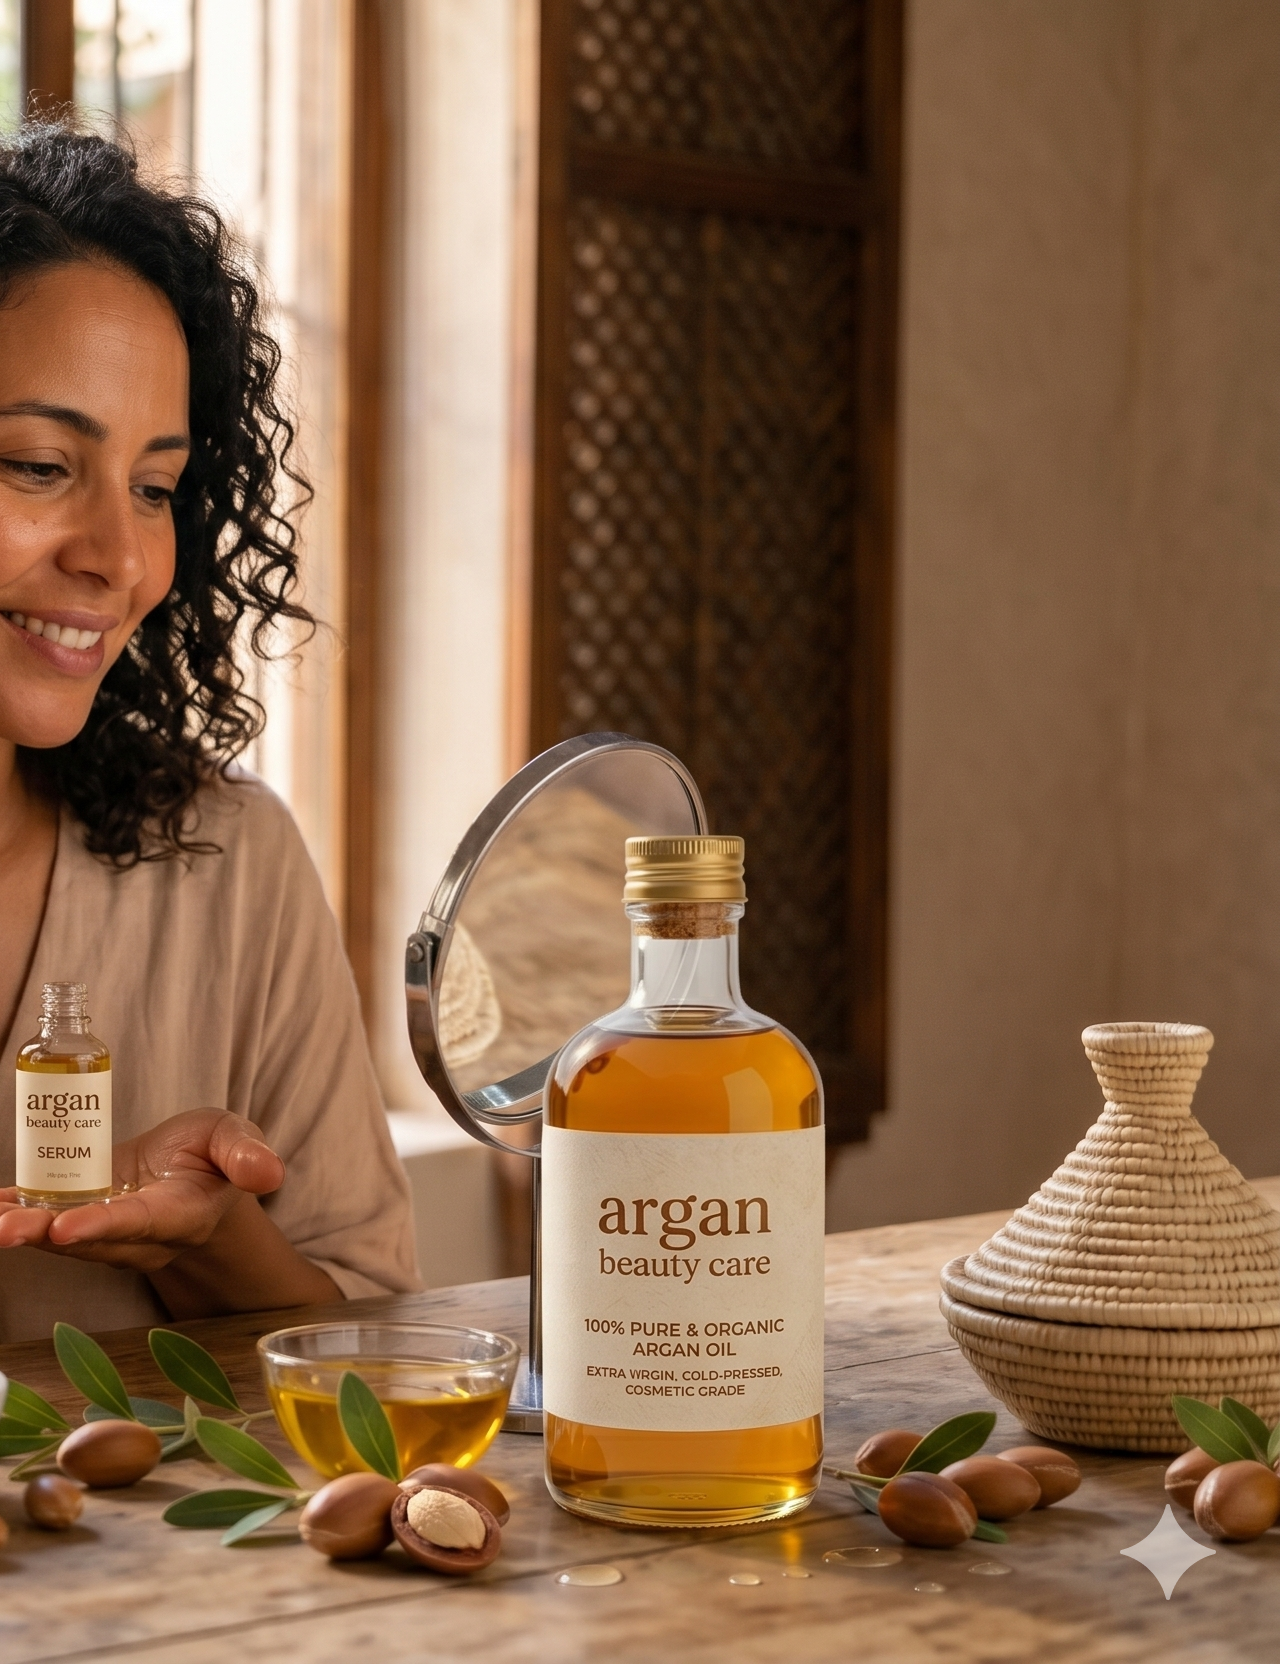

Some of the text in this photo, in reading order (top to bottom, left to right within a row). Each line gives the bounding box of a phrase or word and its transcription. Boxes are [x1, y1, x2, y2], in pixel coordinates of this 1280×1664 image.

[27, 1092, 100, 1117] argan
[26, 1116, 101, 1132] beauty care
[37, 1146, 91, 1159] SERUM
[598, 1195, 771, 1251] argan
[599, 1248, 771, 1285] beauty care
[584, 1318, 785, 1337] 100% PURE & ORGANIC
[633, 1342, 737, 1357] ARGAN OIL
[586, 1366, 626, 1379] EXTRA
[682, 1366, 783, 1381] COLD-PRESSED,
[625, 1385, 746, 1397] COSMETIC GRADE
